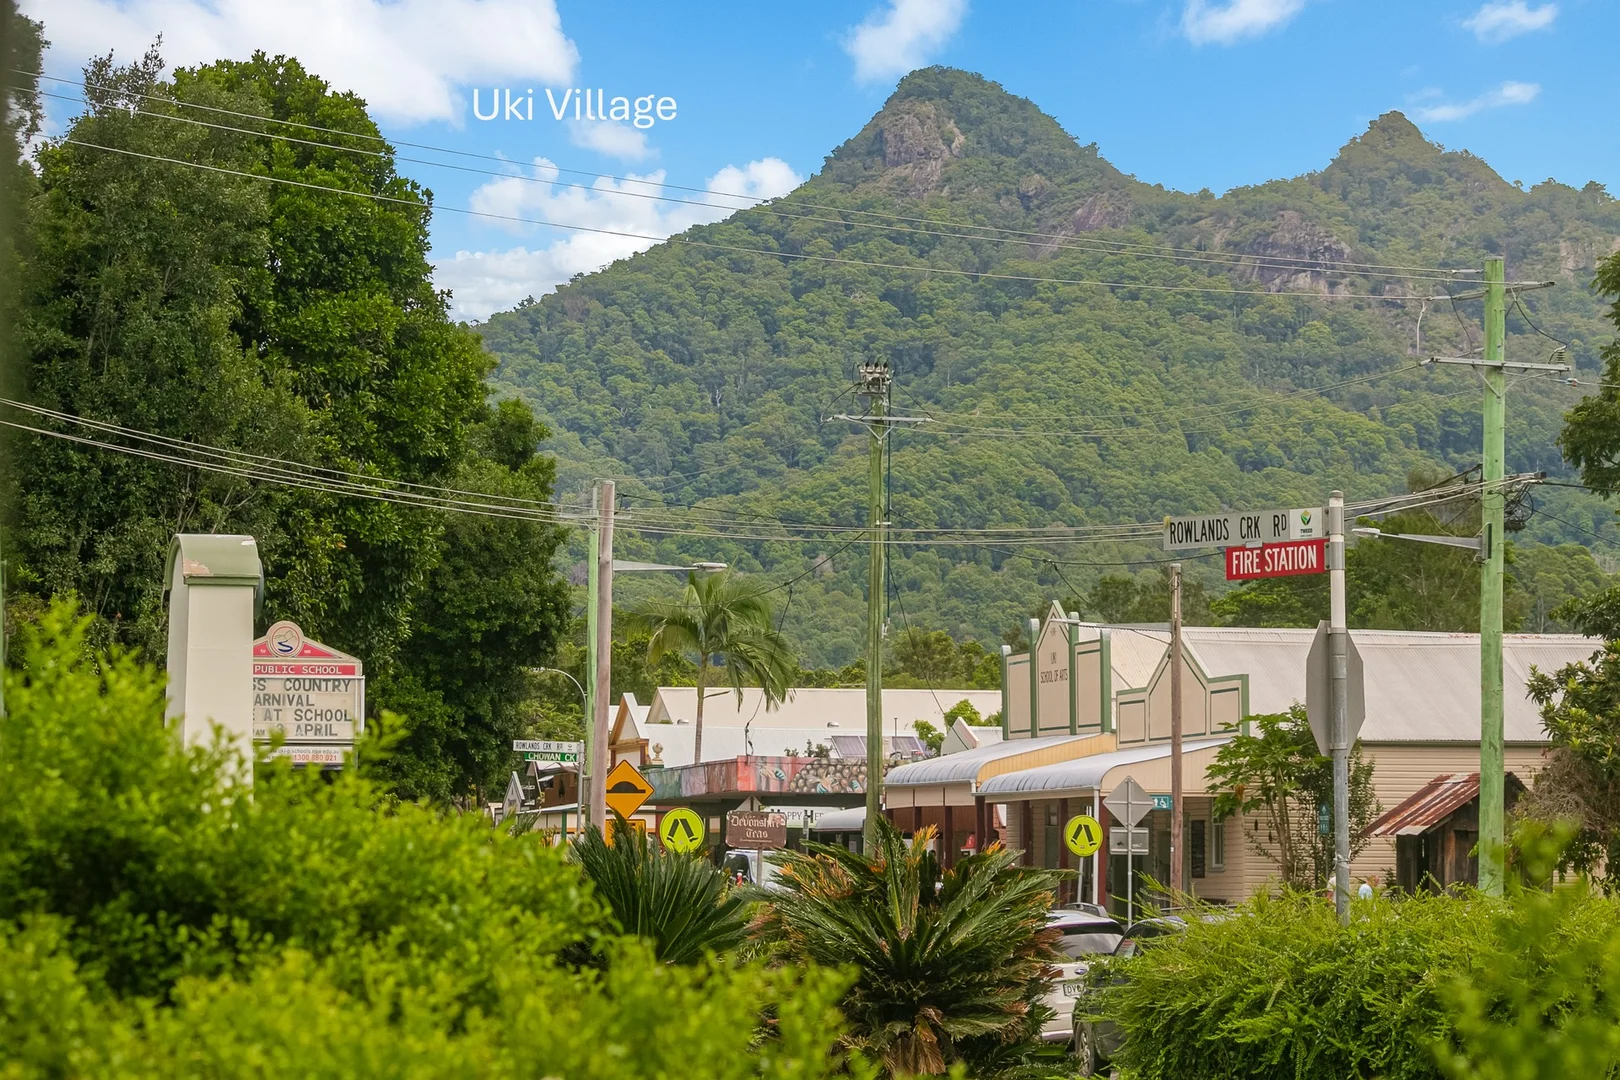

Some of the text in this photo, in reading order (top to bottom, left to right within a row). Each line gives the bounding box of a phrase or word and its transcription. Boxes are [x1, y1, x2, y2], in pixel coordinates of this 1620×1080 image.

[1169, 517, 1229, 544] ROWLANDS
[1239, 515, 1261, 539] CRK
[1232, 544, 1317, 576] FIRE STATION
[254, 665, 342, 675] PUBLIC SCHOOL
[1040, 668, 1068, 683] SCHOOL OF ARTS
[283, 678, 351, 692] COUNTRY
[263, 708, 353, 722] AT SCHOOL
[295, 723, 338, 737] APRIL
[516, 742, 540, 750] ROWLANDS
[543, 742, 552, 750] CRK
[528, 752, 575, 761] CHOWAN CK
[745, 828, 769, 838] Teas
